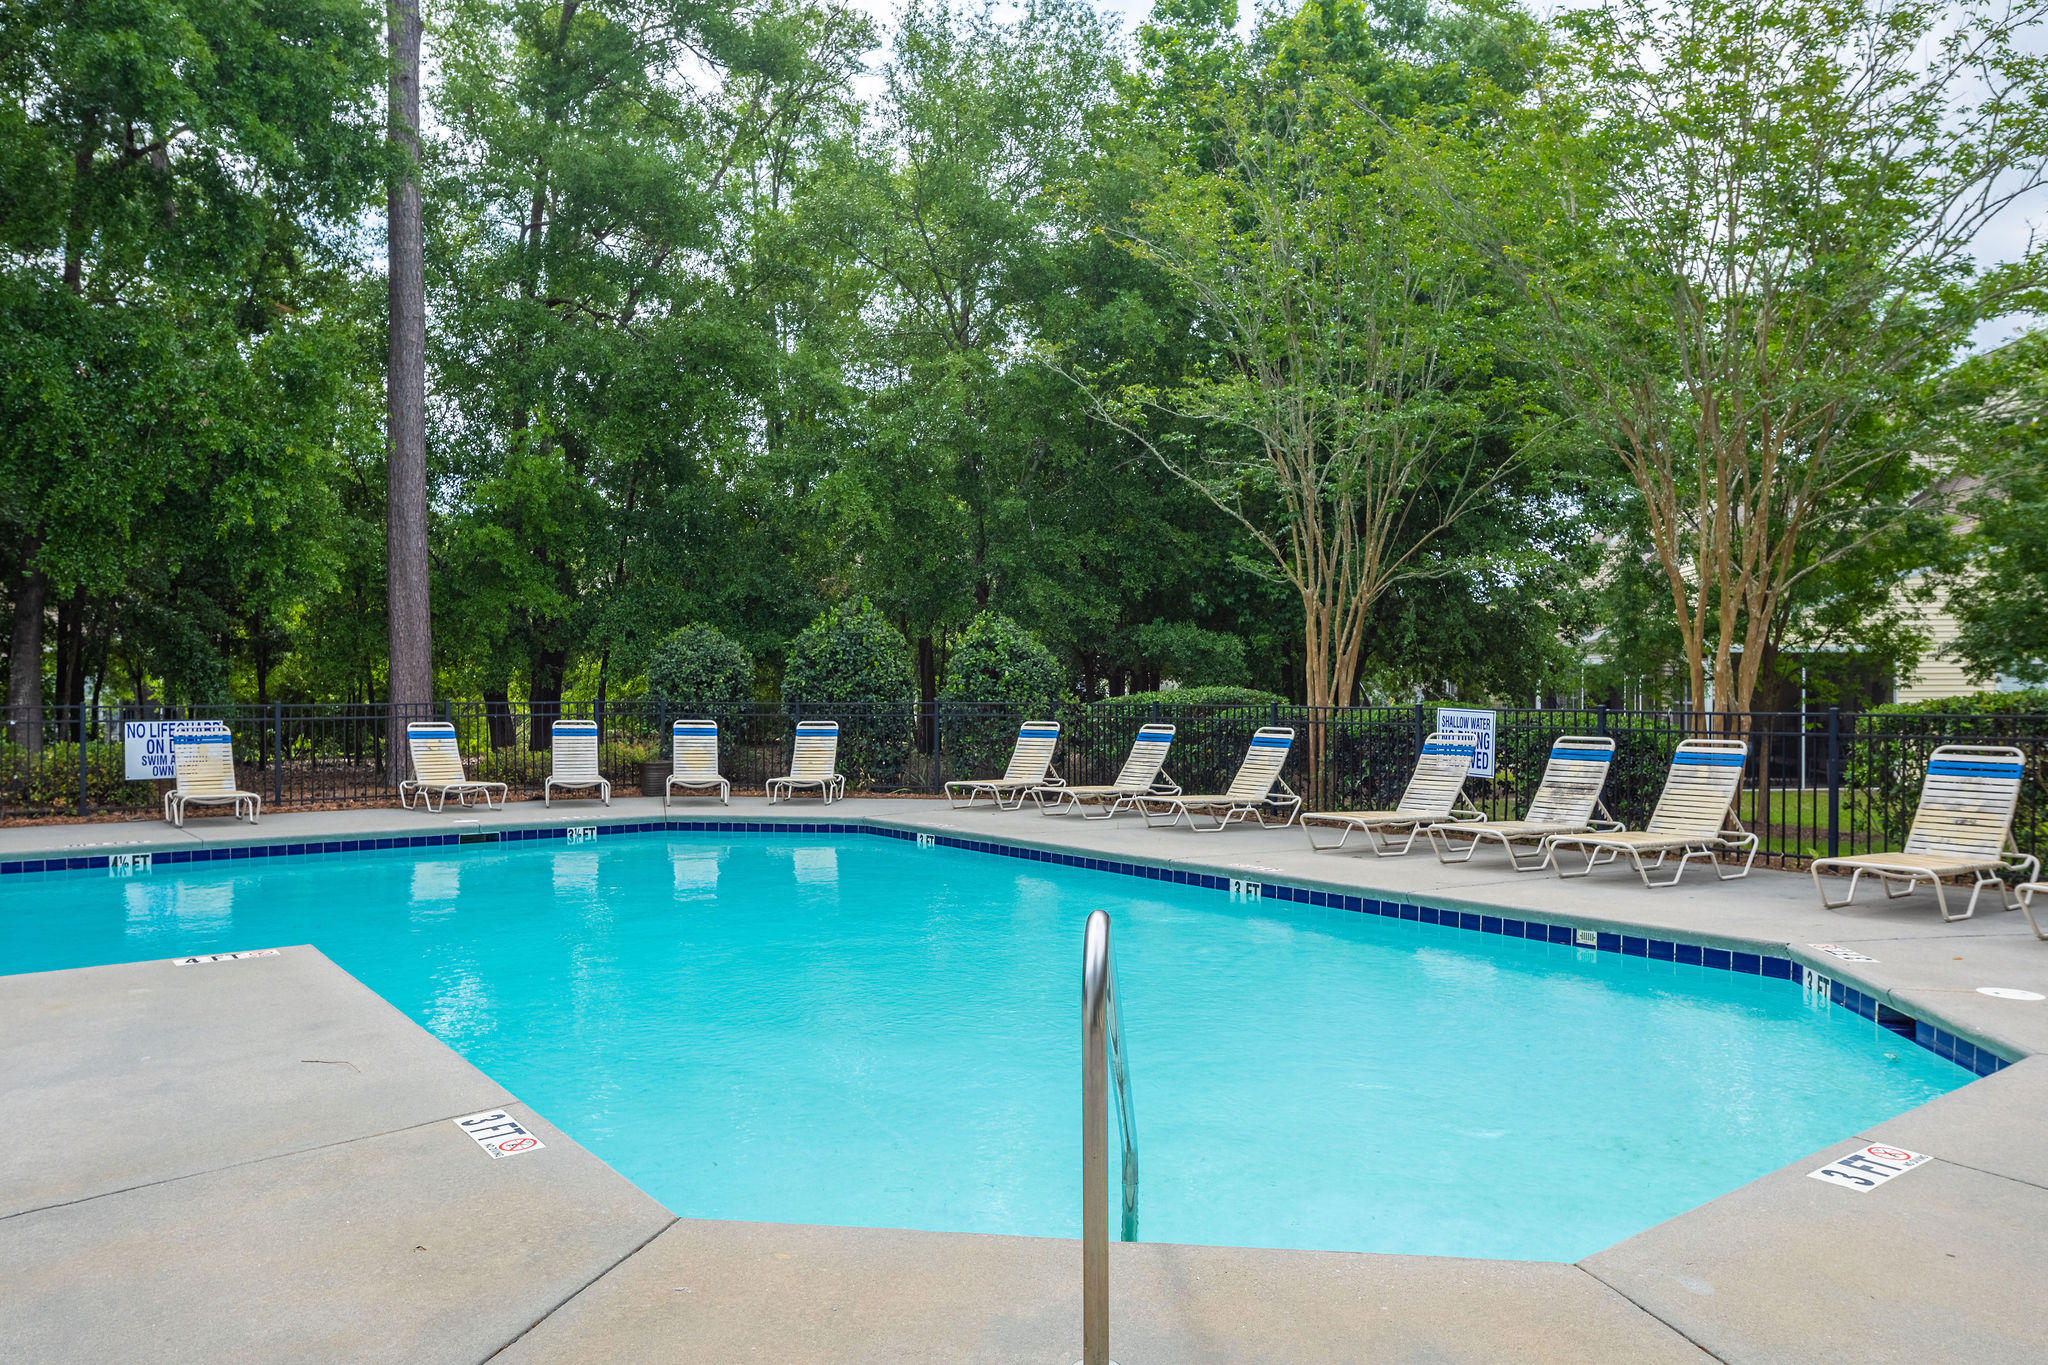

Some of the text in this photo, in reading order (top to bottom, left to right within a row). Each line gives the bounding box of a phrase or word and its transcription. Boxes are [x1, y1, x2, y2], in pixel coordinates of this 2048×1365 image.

[1441, 715, 1491, 730] SHALLOW WATER
[127, 723, 146, 738] NO
[146, 739, 164, 754] ON
[141, 755, 168, 766] SWIM
[152, 766, 174, 777] OWN
[583, 827, 596, 837] FT
[131, 854, 150, 866] FT
[1246, 882, 1260, 897] FT
[1817, 974, 1830, 999] FT
[461, 1114, 526, 1141] 3 FT
[1837, 1154, 1903, 1178] FT
[1821, 1169, 1875, 1186] 3
